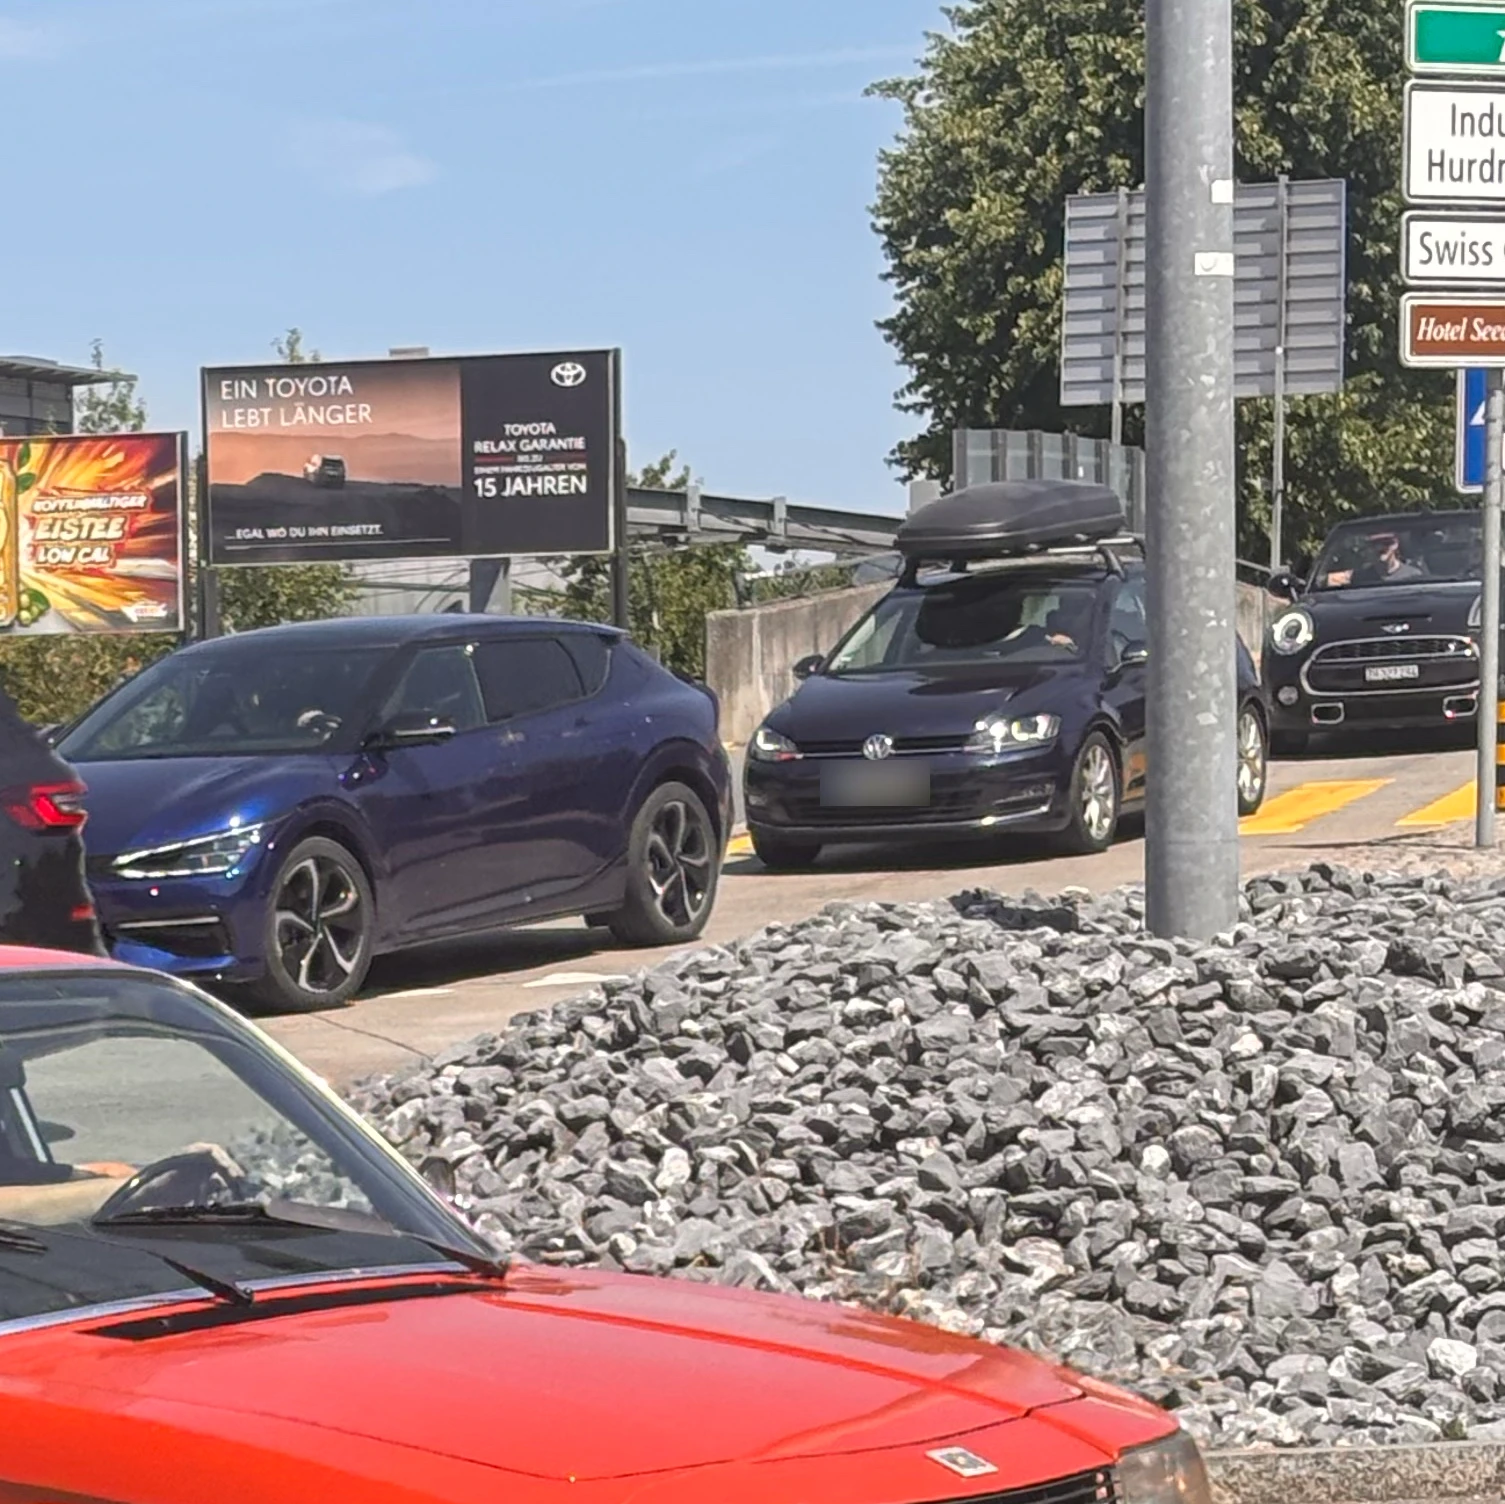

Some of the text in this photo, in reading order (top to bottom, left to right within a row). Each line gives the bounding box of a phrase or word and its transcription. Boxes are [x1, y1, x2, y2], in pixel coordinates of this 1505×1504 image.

[1419, 231, 1493, 266] Swiss
[1416, 316, 1468, 342] Hotel
[220, 375, 353, 400] EIN TOYOTA
[222, 402, 372, 428] LEBT LÄNGER
[503, 422, 556, 436] TOYOTA
[474, 437, 586, 453] RELAX GARANTIE
[474, 474, 587, 497] 15 JAHREN
[36, 517, 125, 540] EISTEE
[289, 527, 306, 537] DU
[38, 546, 110, 564] LOW CAL
